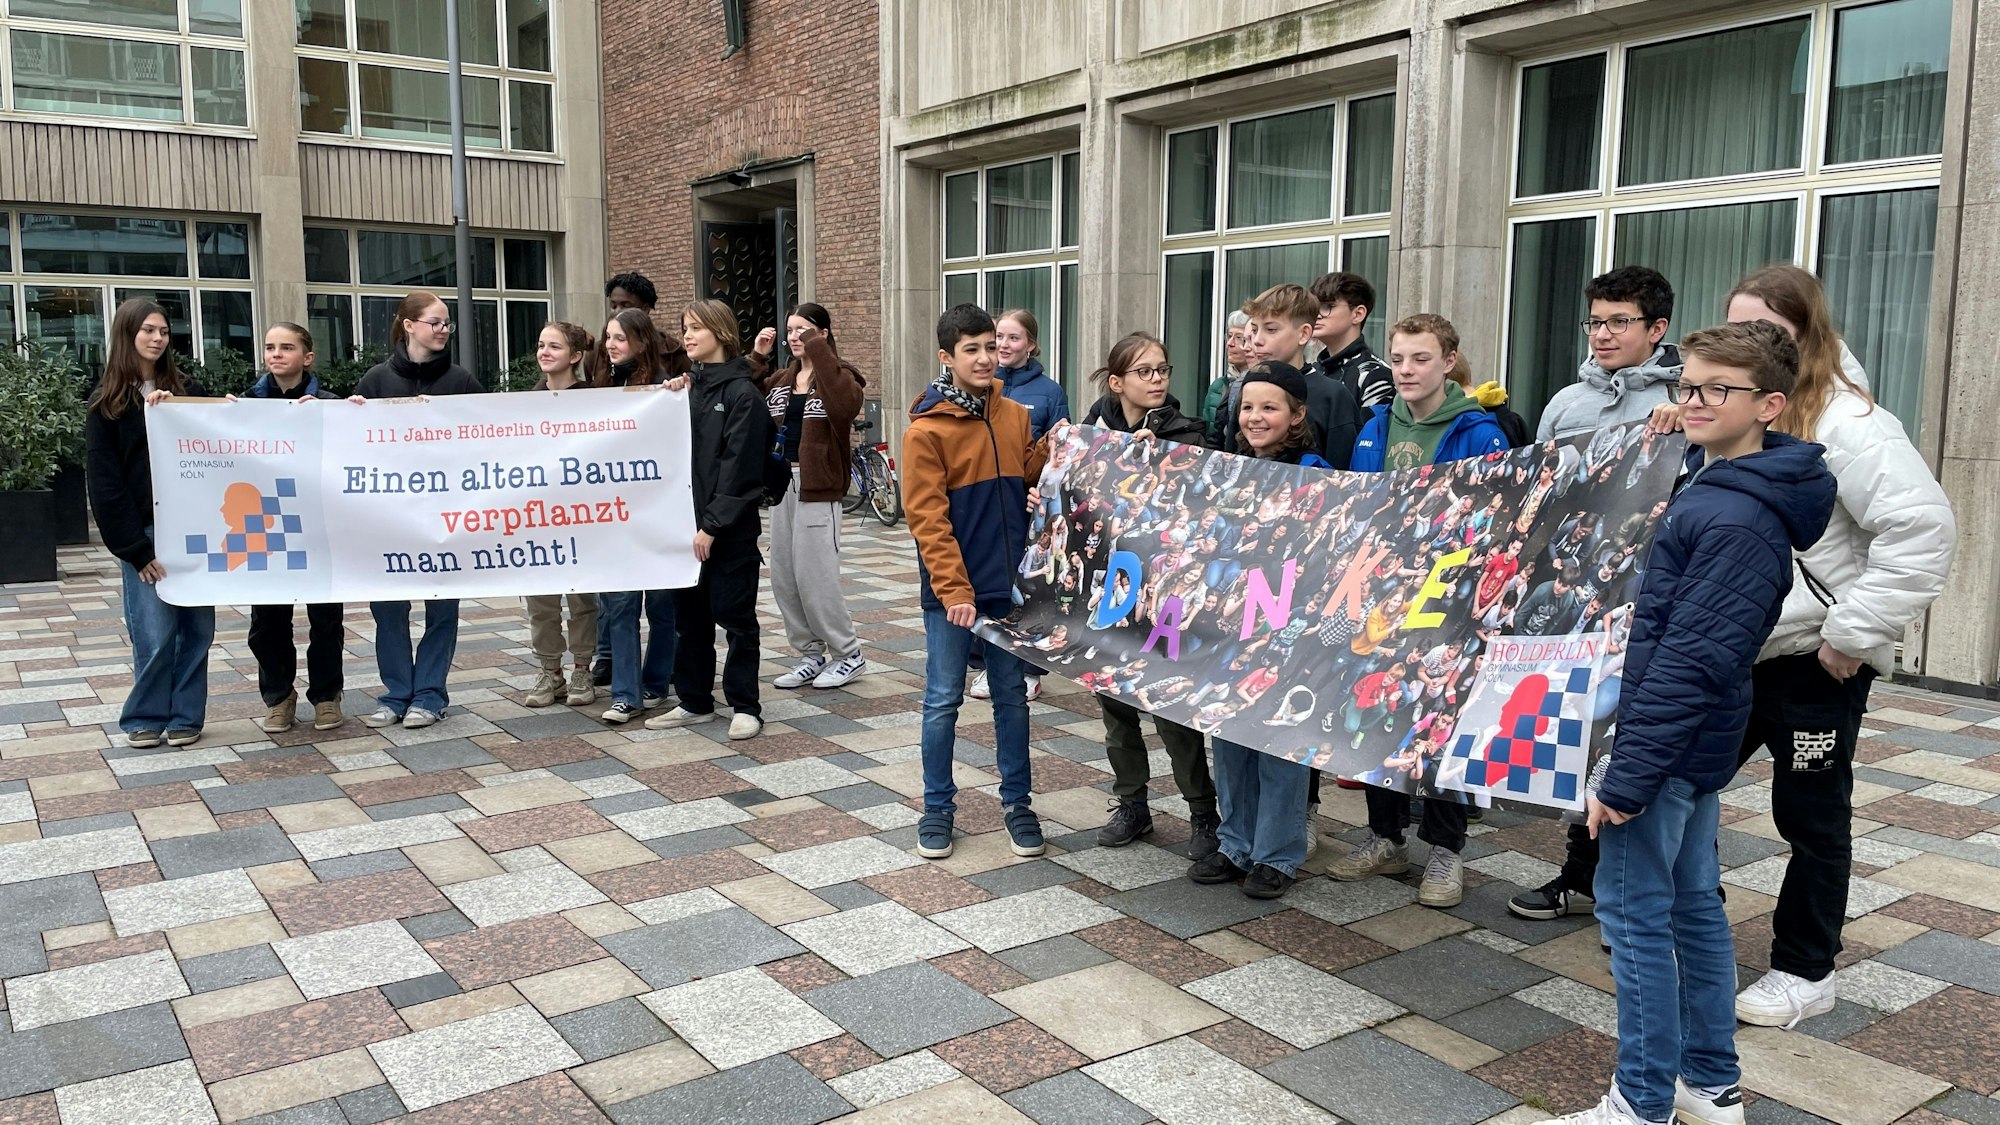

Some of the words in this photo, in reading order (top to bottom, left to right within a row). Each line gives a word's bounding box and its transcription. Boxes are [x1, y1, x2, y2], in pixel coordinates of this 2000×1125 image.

[366, 429, 398, 443] 111
[403, 427, 452, 442] Jahre
[457, 422, 535, 440] Hölderlin
[540, 417, 637, 438] Gymnasium
[177, 438, 297, 455] HÖLDERLIN
[179, 460, 235, 469] GYMNASIUM
[180, 470, 205, 479] KÖLN
[342, 465, 450, 494] Einen
[461, 462, 549, 492] alten
[559, 456, 662, 486] Baum
[441, 496, 630, 536] verpflanzt
[383, 551, 462, 574] man
[472, 536, 578, 570] nicht!
[1491, 641, 1600, 661] HÖLDERLIN
[1483, 673, 1504, 683] KÖLN
[1487, 663, 1538, 672] GYMNASIUM
[1793, 731, 1809, 769] EDGE
[1808, 731, 1824, 759] THE
[1822, 730, 1836, 751] TO
